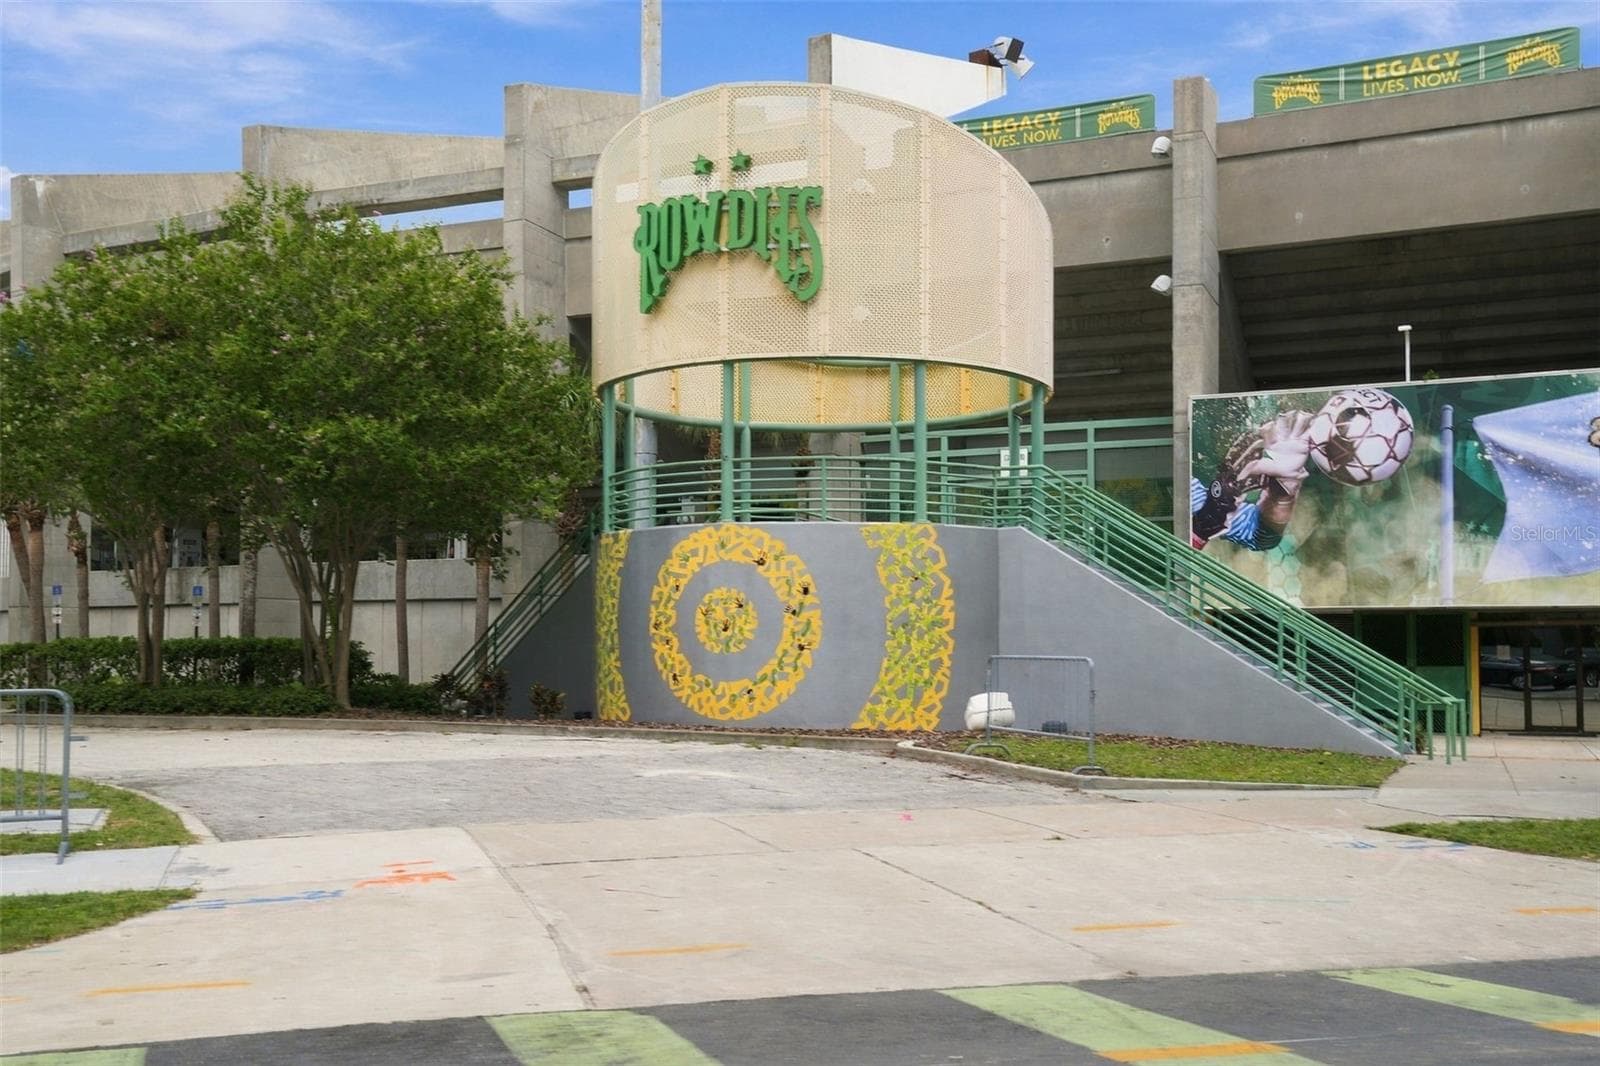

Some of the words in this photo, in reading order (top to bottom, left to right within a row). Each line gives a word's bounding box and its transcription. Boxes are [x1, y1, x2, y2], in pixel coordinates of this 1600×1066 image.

[1362, 50, 1461, 80] LEGACY.
[1363, 78, 1409, 97] LIVES.
[1413, 70, 1461, 89] NOW.
[981, 111, 1062, 136] LEGACY.
[1023, 127, 1062, 144] NOW.
[634, 186, 824, 314] ROWDIES
